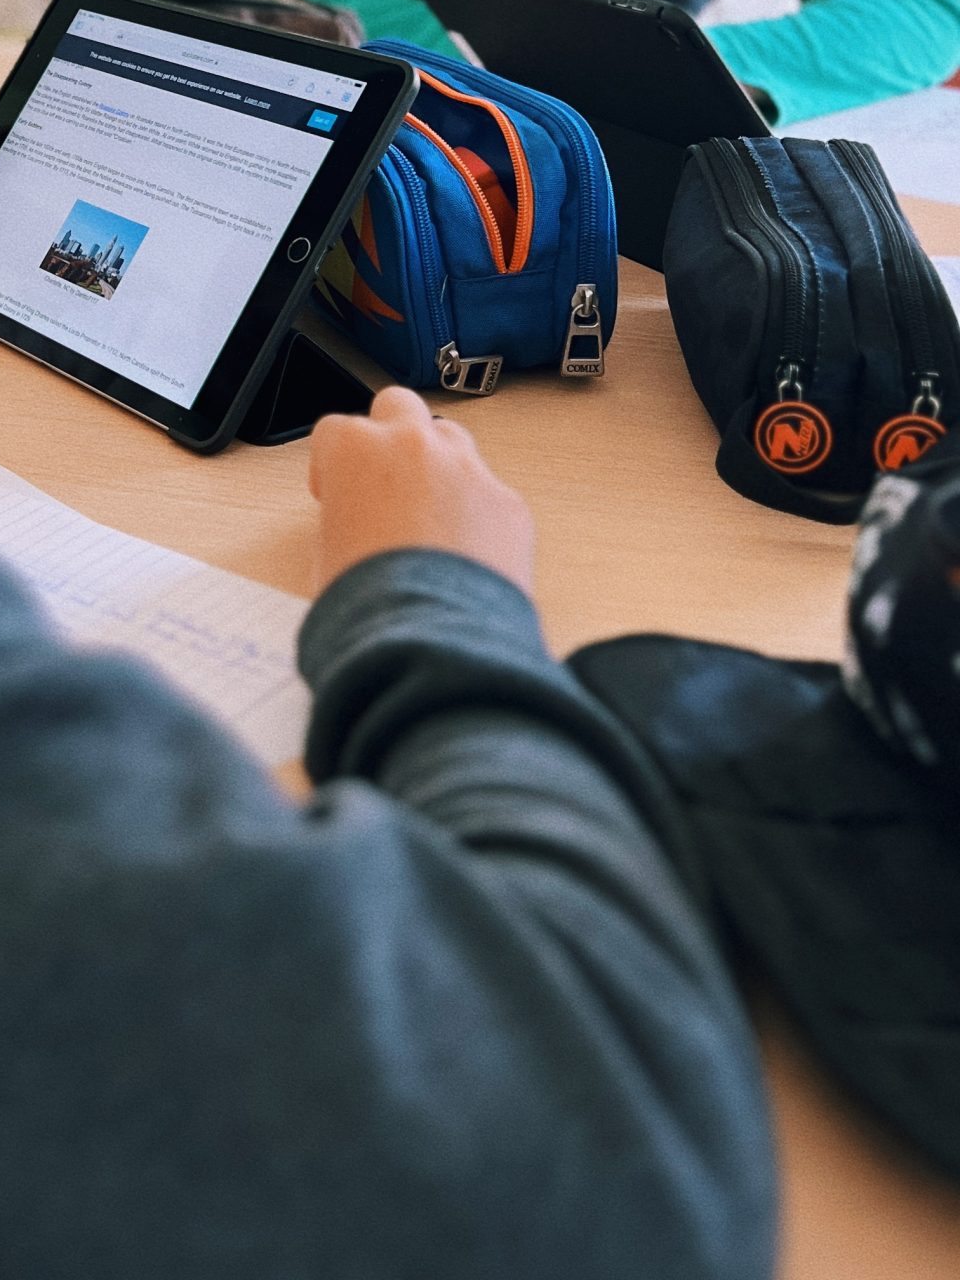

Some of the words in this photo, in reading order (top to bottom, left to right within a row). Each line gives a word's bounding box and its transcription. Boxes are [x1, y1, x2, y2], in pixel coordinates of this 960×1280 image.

[120, 60, 137, 70] cookies
[139, 66, 156, 75] ensure
[185, 79, 210, 91] experience
[484, 361, 501, 392] COMIX
[566, 364, 600, 373] COMIX
